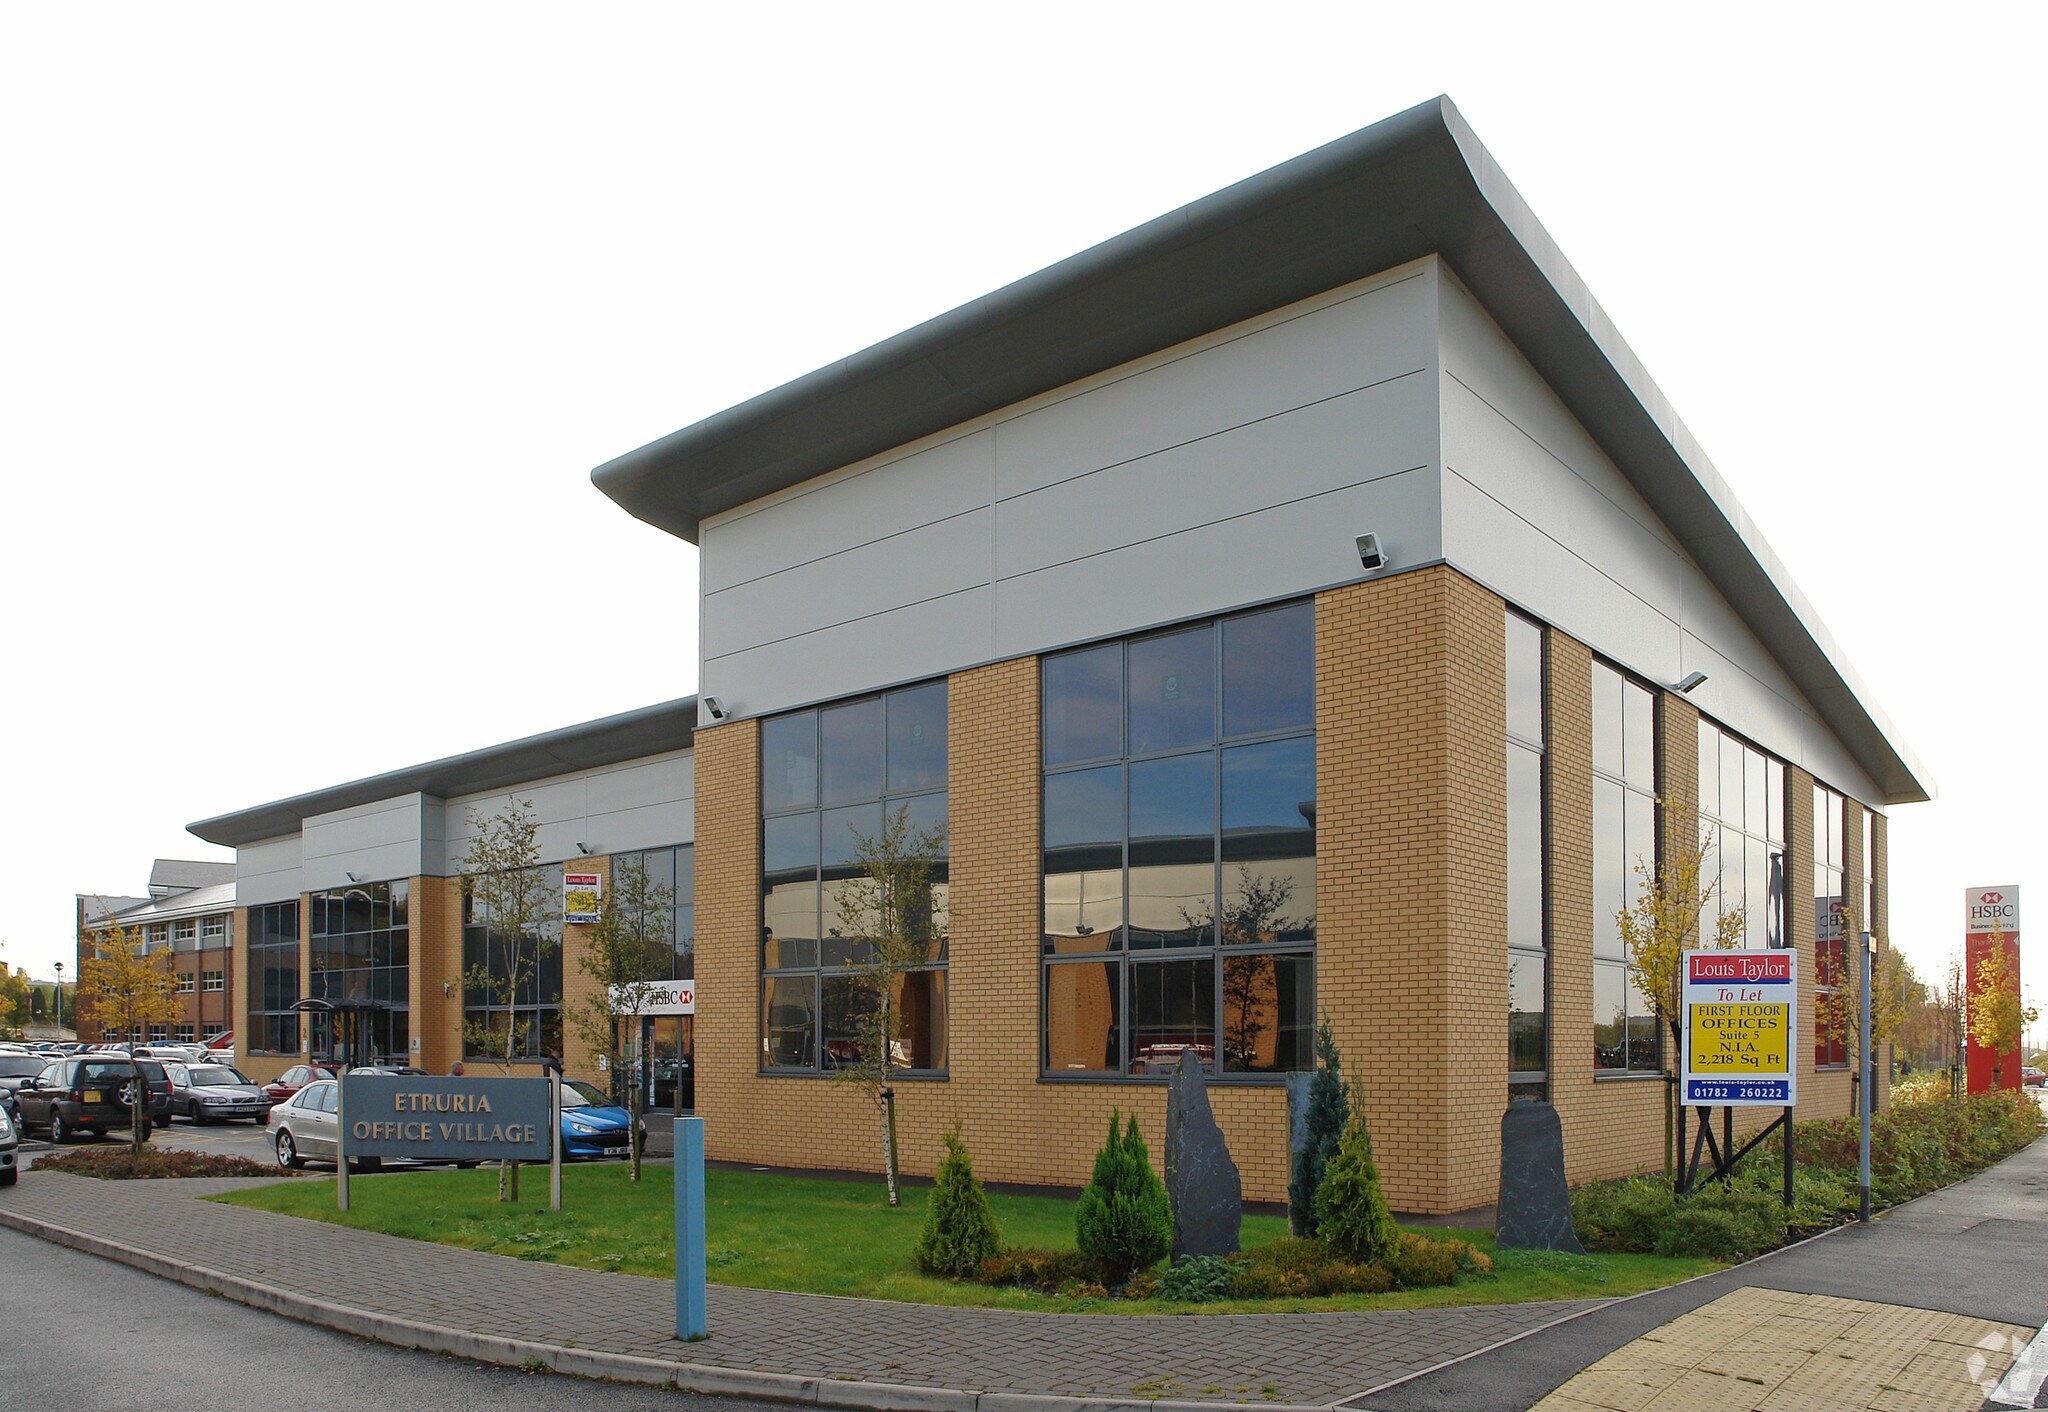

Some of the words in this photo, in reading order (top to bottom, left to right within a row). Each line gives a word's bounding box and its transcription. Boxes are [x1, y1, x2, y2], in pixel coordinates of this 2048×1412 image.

[1971, 905, 2013, 918] HSBC
[1694, 958, 1735, 976] Louis
[1738, 958, 1785, 982] Taylor
[650, 990, 678, 1005] HSBC
[1717, 988, 1734, 1001] To
[1740, 988, 1763, 1001] Let
[1698, 1005, 1734, 1016] FIRST
[1740, 1005, 1781, 1016] FLOOR
[1701, 1018, 1778, 1029] OFFICES
[1719, 1030, 1748, 1040] Suite
[1753, 1030, 1760, 1040] 5
[1719, 1042, 1760, 1052] N.I.A.
[1698, 1054, 1734, 1066] 2,218
[1740, 1054, 1759, 1067] Sq
[1766, 1054, 1780, 1064] Ft
[1694, 1087, 1728, 1097] 01782
[1739, 1087, 1782, 1098] 260222
[394, 1092, 492, 1113] ETRURIA
[353, 1121, 433, 1141] OFFICE
[439, 1122, 537, 1144] VILLAGE
